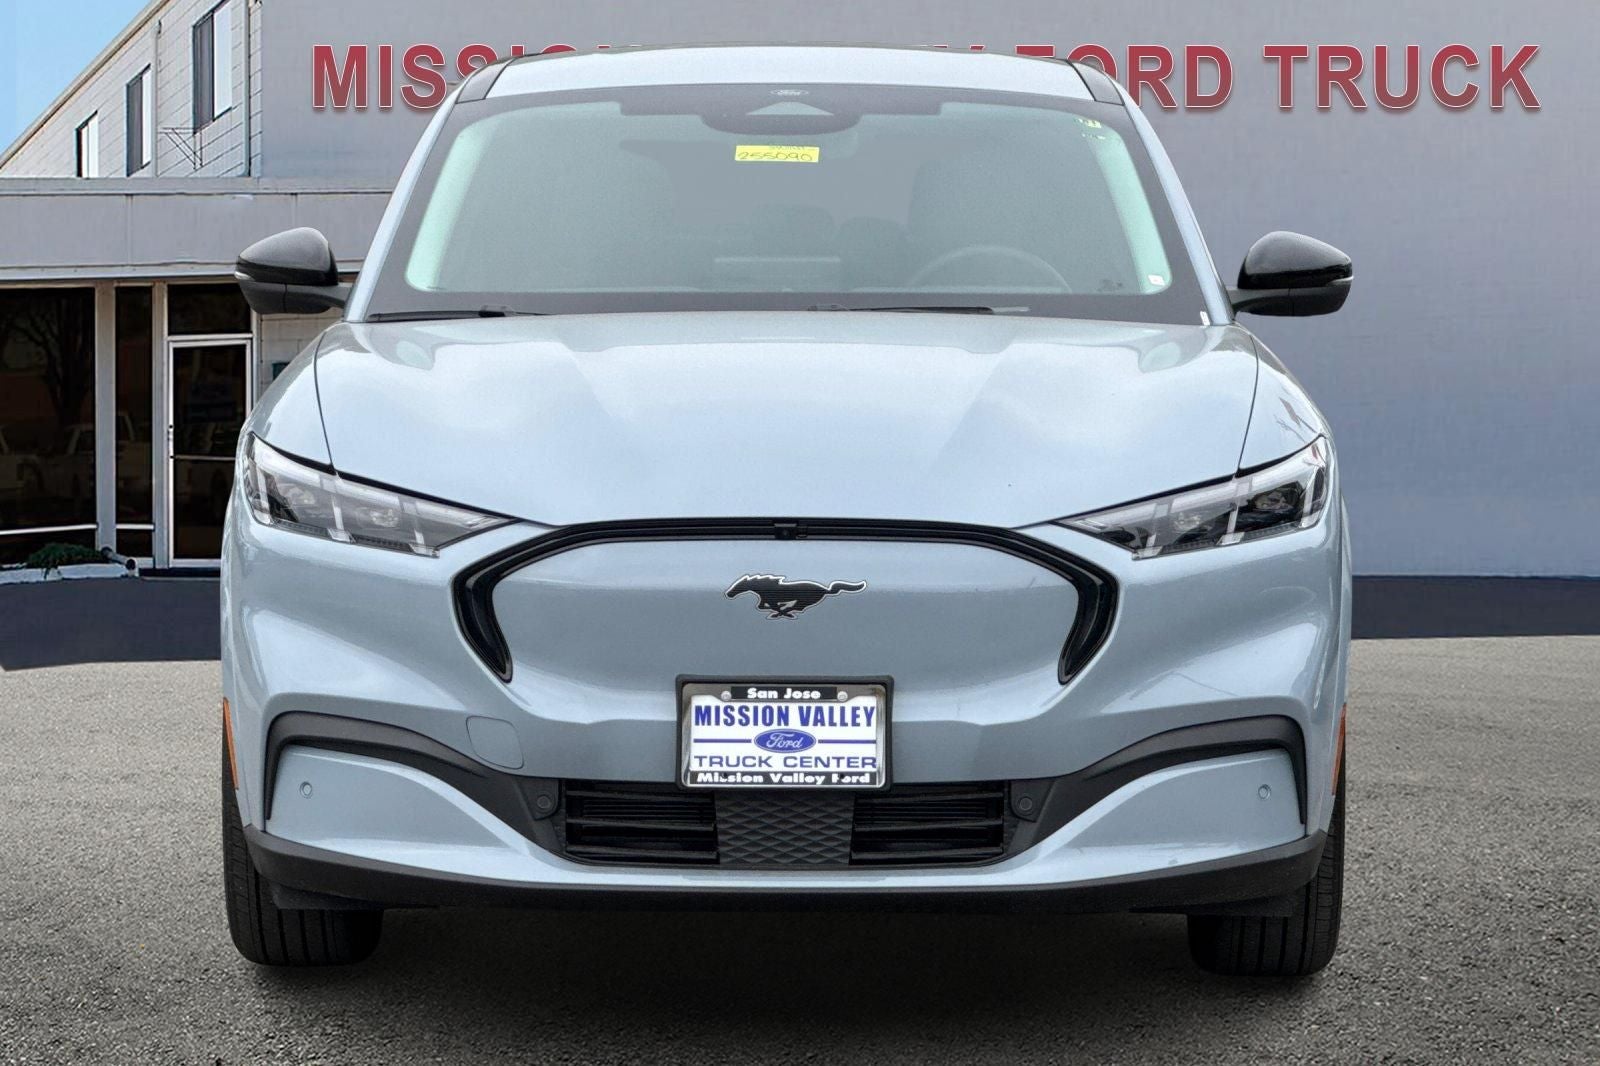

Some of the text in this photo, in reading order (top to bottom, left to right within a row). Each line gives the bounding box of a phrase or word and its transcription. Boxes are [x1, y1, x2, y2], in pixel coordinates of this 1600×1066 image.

[1015, 44, 1233, 109] ORD
[1263, 44, 1541, 109] TRUCK
[747, 687, 821, 699] San Jose
[694, 705, 875, 727] MISSION VALLEY
[766, 732, 804, 748] Ford
[694, 755, 877, 769] TRUCK CENTER
[769, 772, 826, 785] Valley
